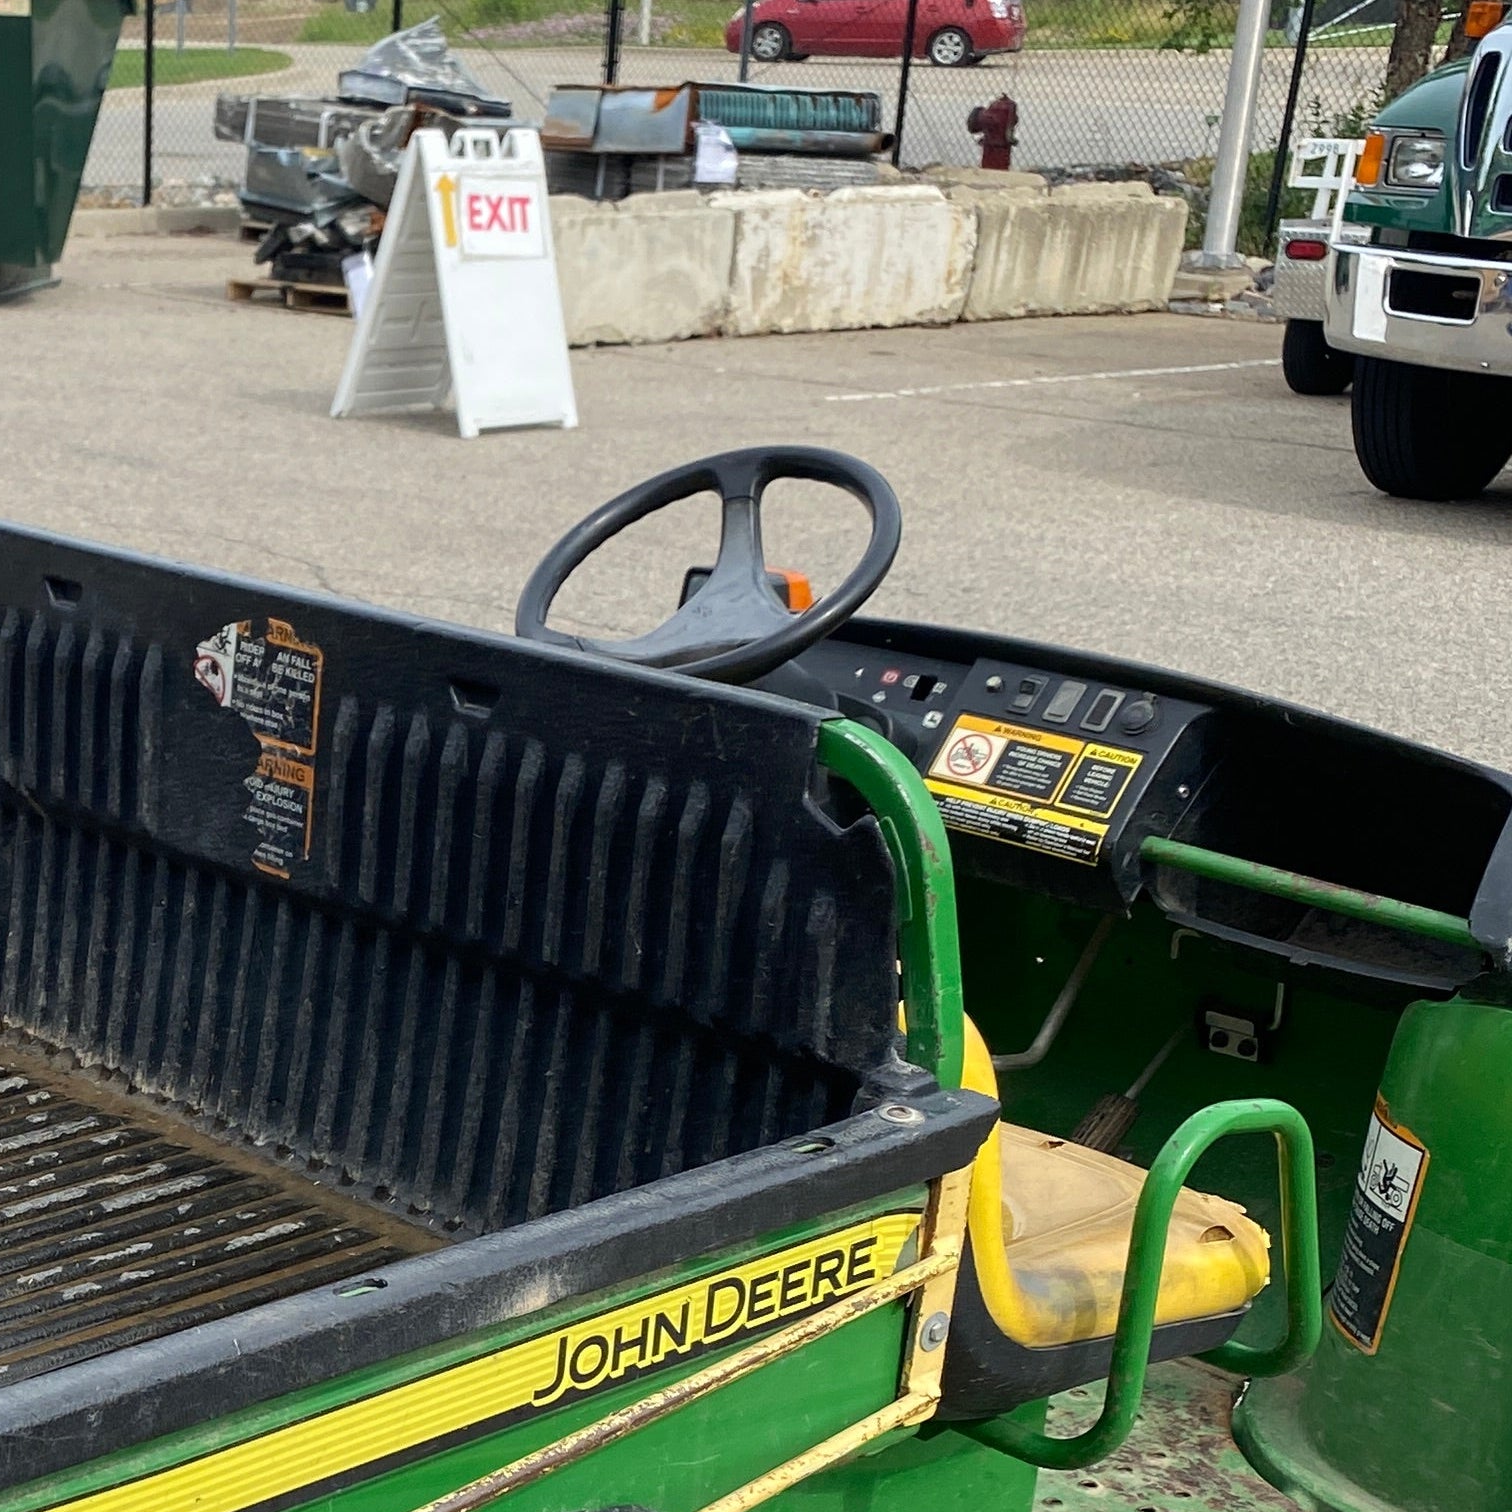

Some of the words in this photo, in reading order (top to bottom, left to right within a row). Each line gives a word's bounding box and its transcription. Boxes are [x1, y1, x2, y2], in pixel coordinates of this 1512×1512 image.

[468, 194, 531, 232] EXIT
[235, 653, 251, 667] OFF
[285, 667, 316, 684] KILLED
[291, 654, 313, 670] FALL
[1002, 727, 1042, 742] WARNING
[1097, 750, 1139, 765] CAUTION
[255, 791, 304, 815] EXPLOSION
[998, 800, 1036, 815] CAUTION
[1381, 1217, 1397, 1233] OFF
[532, 1297, 692, 1402] JOHN
[704, 1235, 879, 1334] DEERE
